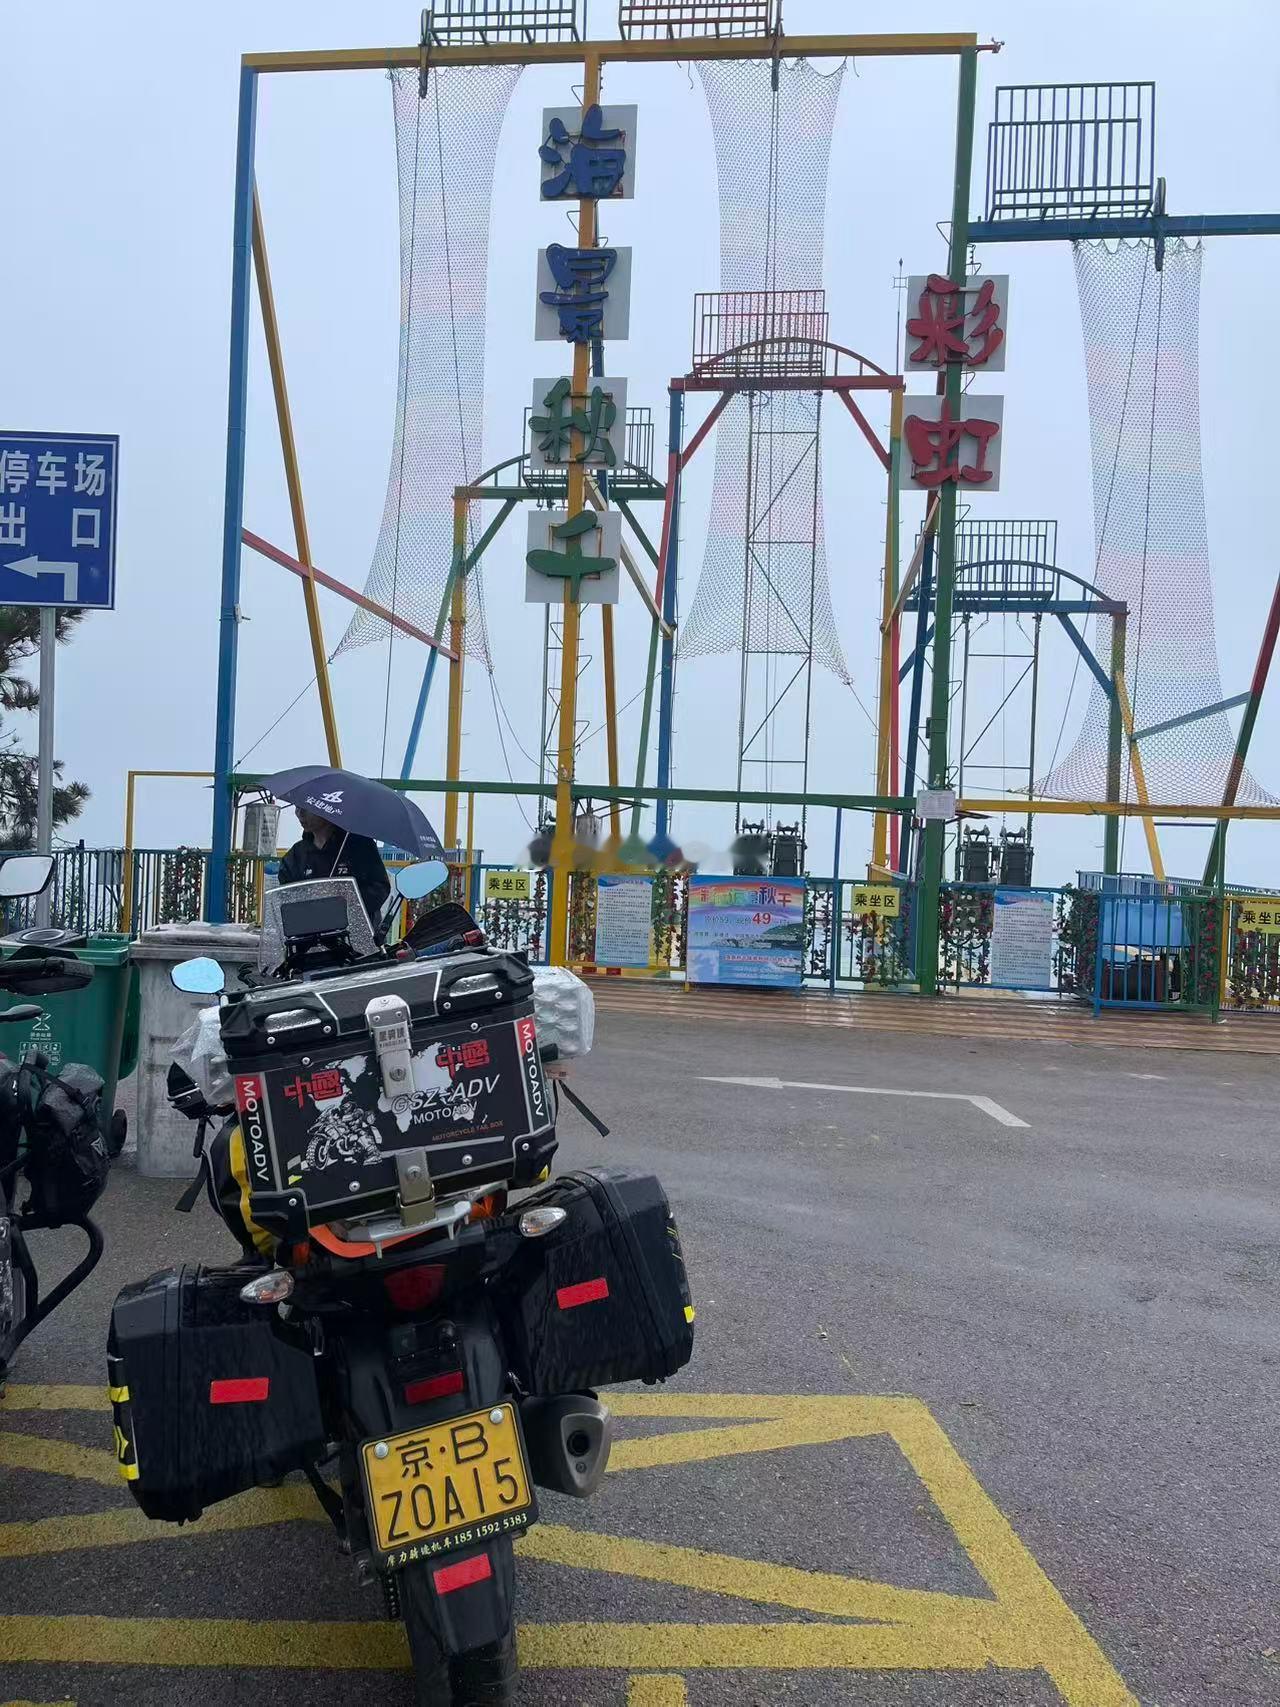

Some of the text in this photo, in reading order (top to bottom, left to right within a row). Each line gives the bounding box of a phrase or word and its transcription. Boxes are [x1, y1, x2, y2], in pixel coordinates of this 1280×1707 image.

[904, 274, 1003, 486] 彩虹
[0, 450, 106, 496] 停车场
[0, 502, 100, 548] 出口
[489, 877, 526, 891] 乘坐区
[855, 893, 895, 907] 乘坐区
[521, 1024, 544, 1116] MOTOADV
[241, 1081, 270, 1182] MOTOADV
[413, 1101, 477, 1125] MOTOADV
[454, 1530, 473, 1545] 185
[476, 1521, 500, 1538] 1592
[503, 1513, 527, 1529] 5383
